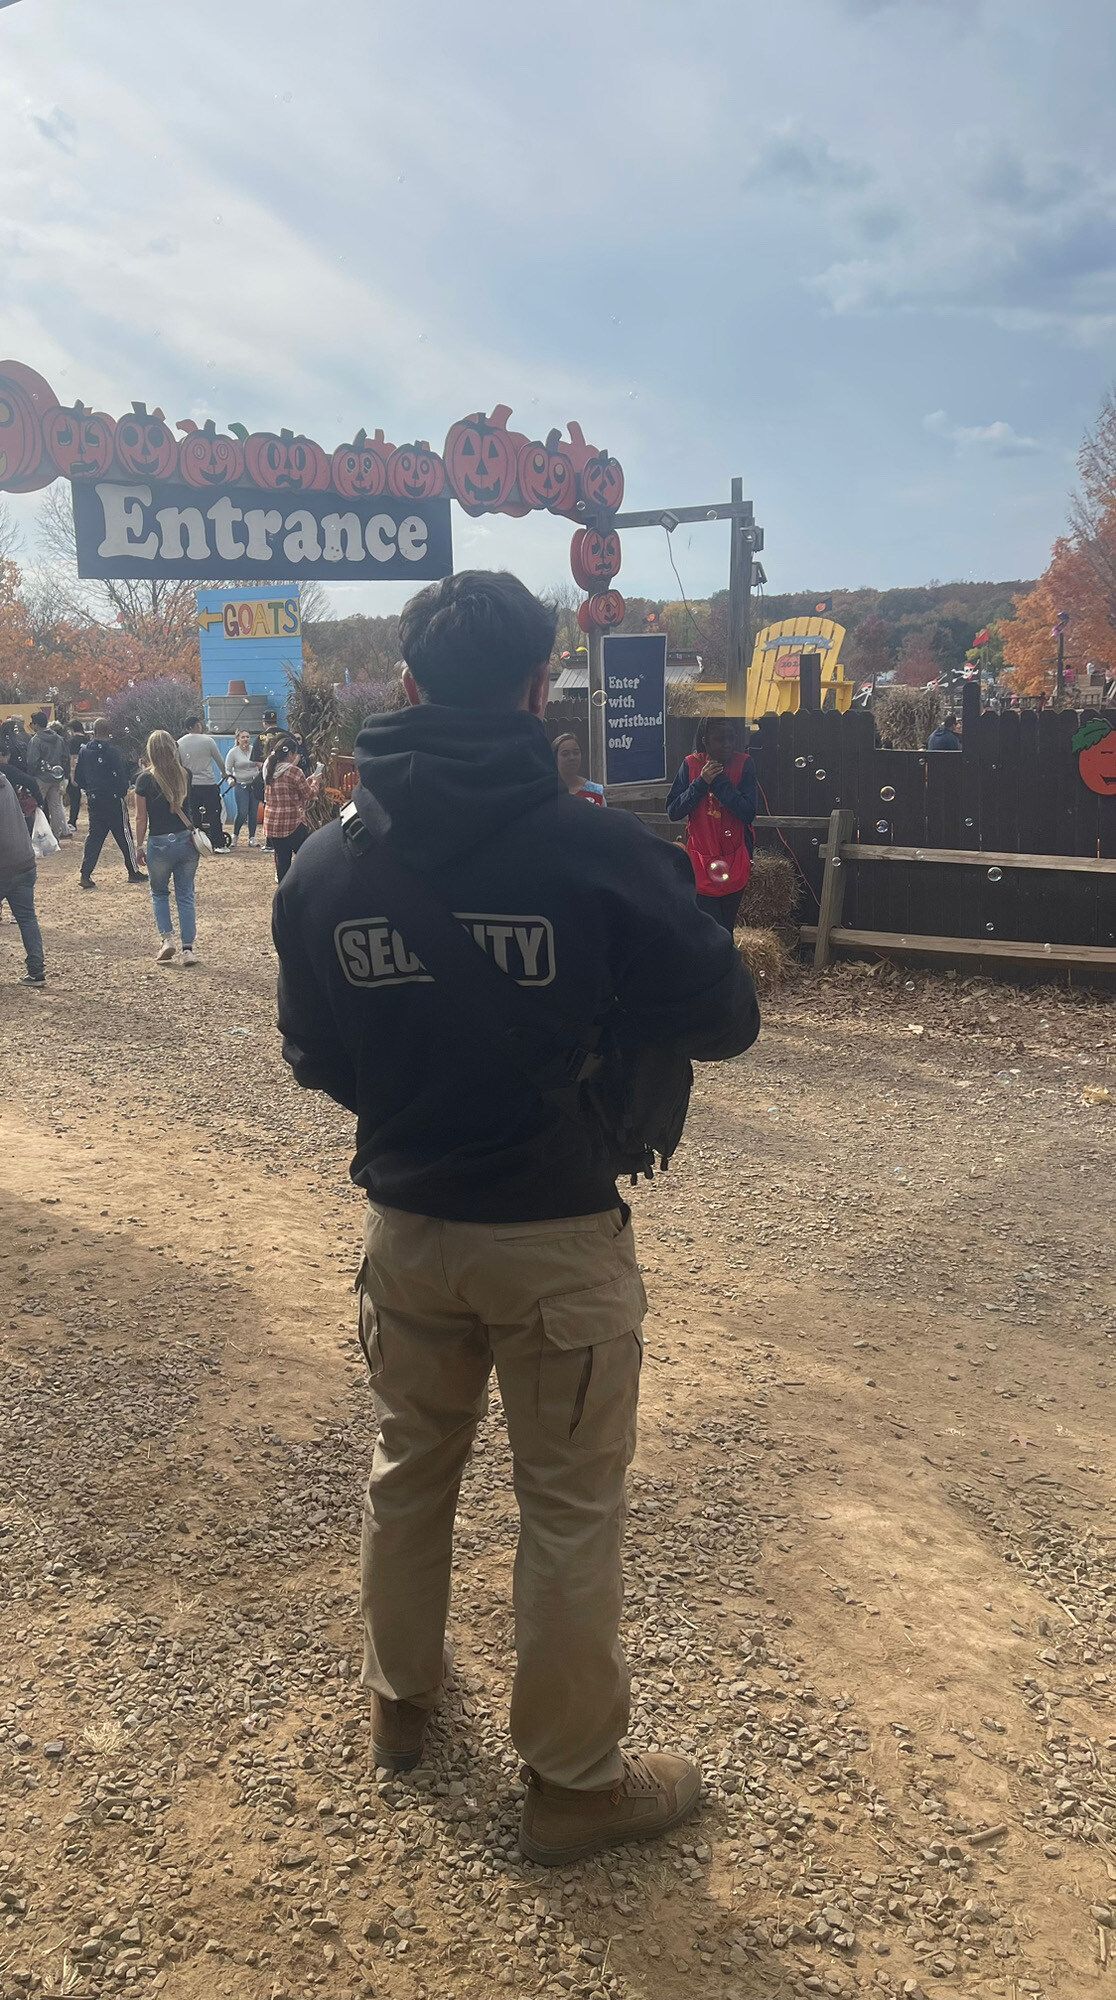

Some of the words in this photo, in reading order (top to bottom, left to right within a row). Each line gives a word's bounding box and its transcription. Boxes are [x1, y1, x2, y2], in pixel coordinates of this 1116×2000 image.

[95, 483, 428, 563] Entrance
[224, 599, 298, 637] GOATS
[608, 675, 640, 689] Enter
[608, 694, 635, 708] with
[608, 711, 663, 728] wristband
[608, 734, 633, 750] only
[341, 922, 544, 978] SECTY
